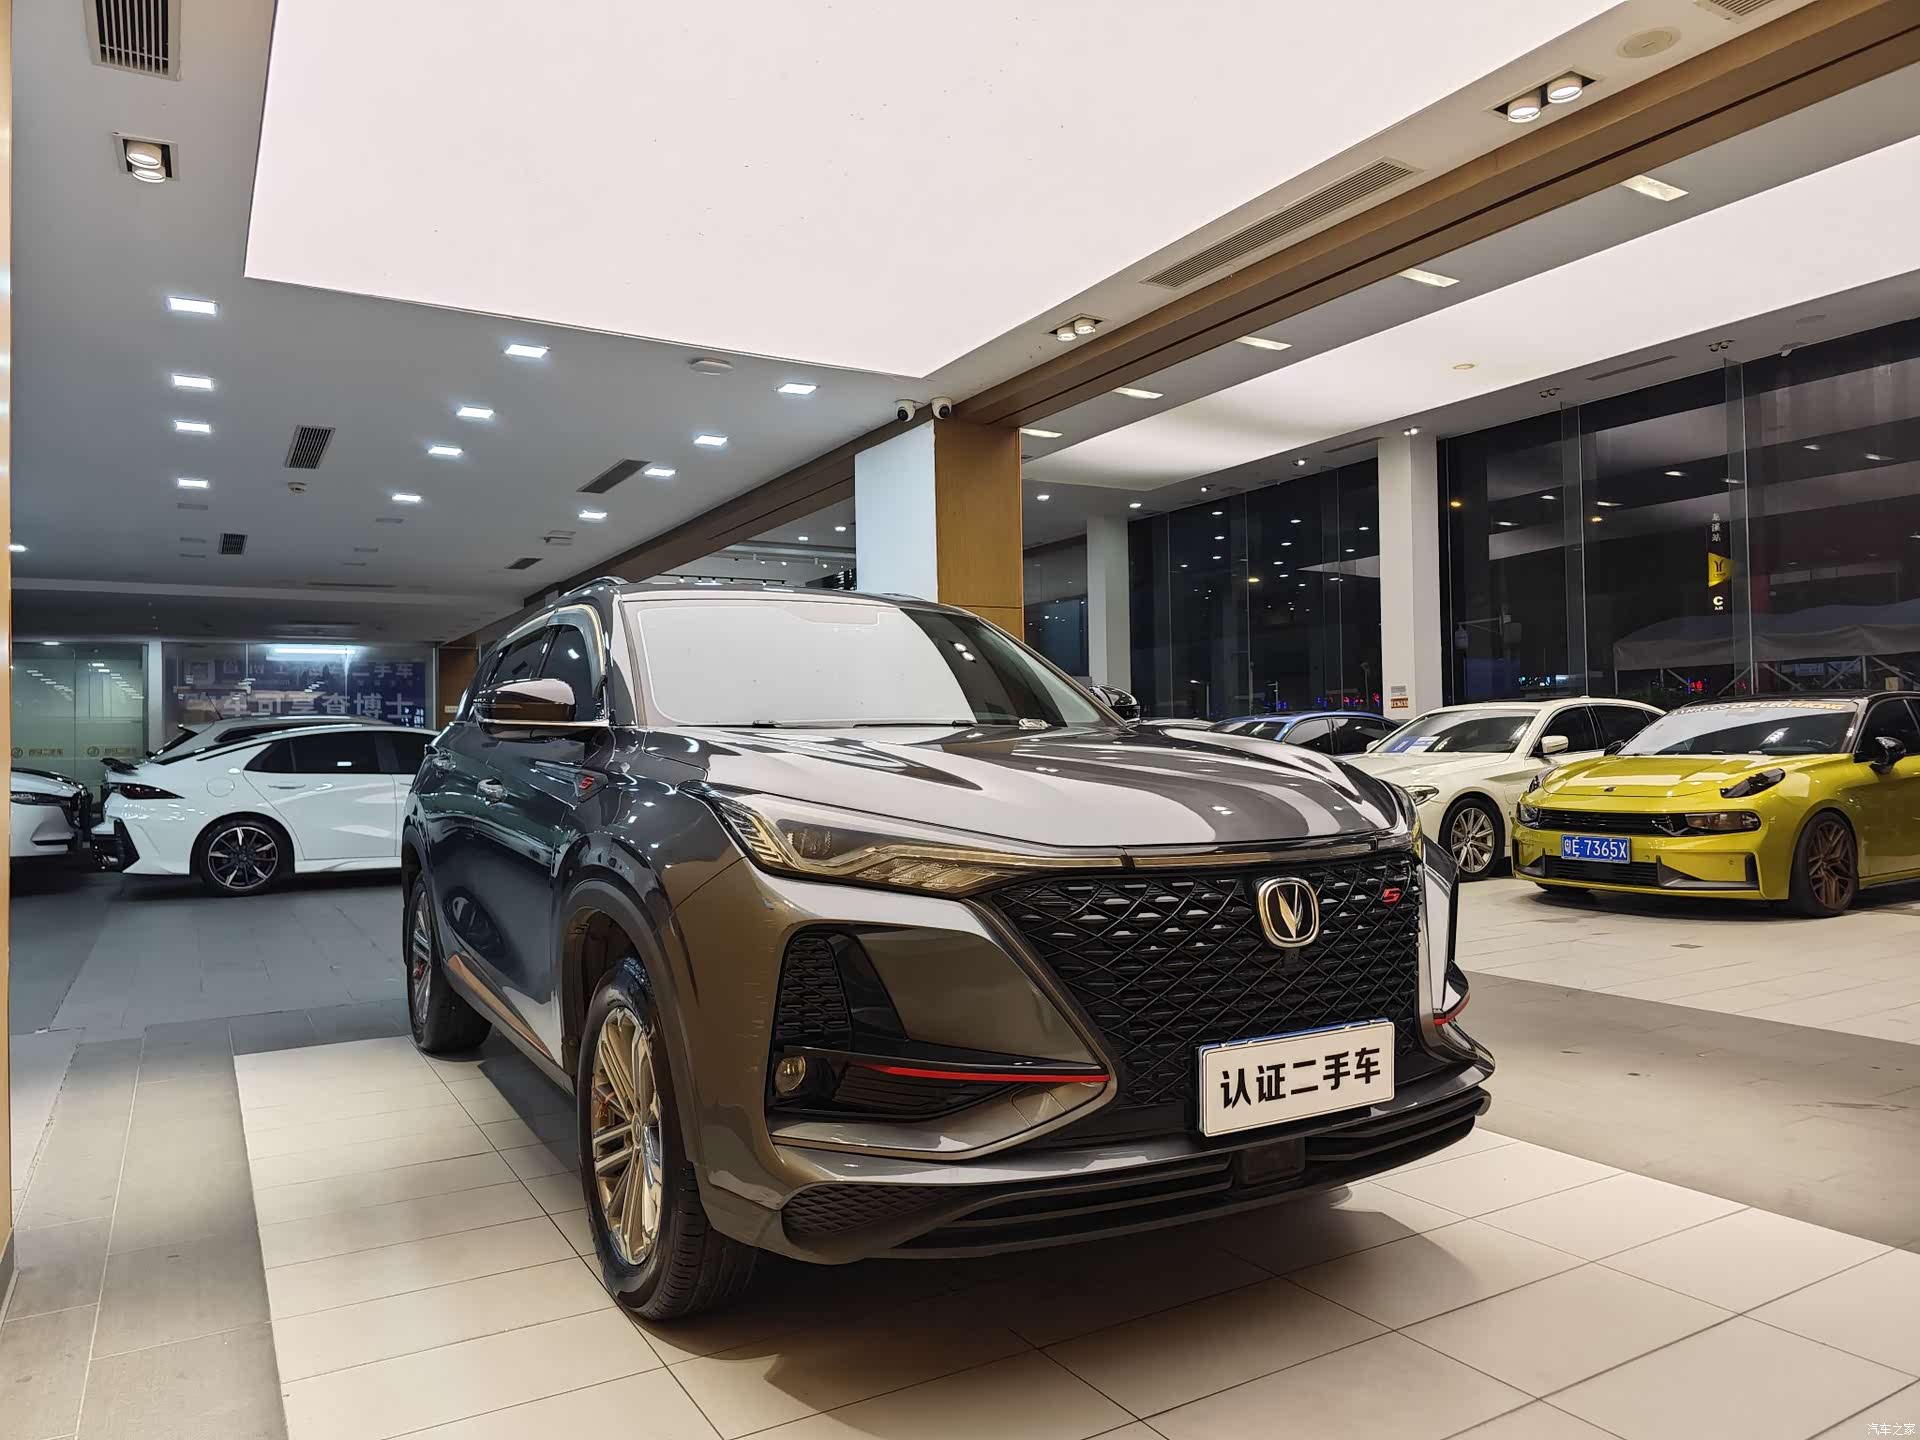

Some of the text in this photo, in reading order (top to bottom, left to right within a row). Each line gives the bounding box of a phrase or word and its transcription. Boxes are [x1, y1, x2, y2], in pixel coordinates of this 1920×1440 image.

[1713, 596, 1724, 606] C
[1220, 1047, 1381, 1109] 认证二手车
